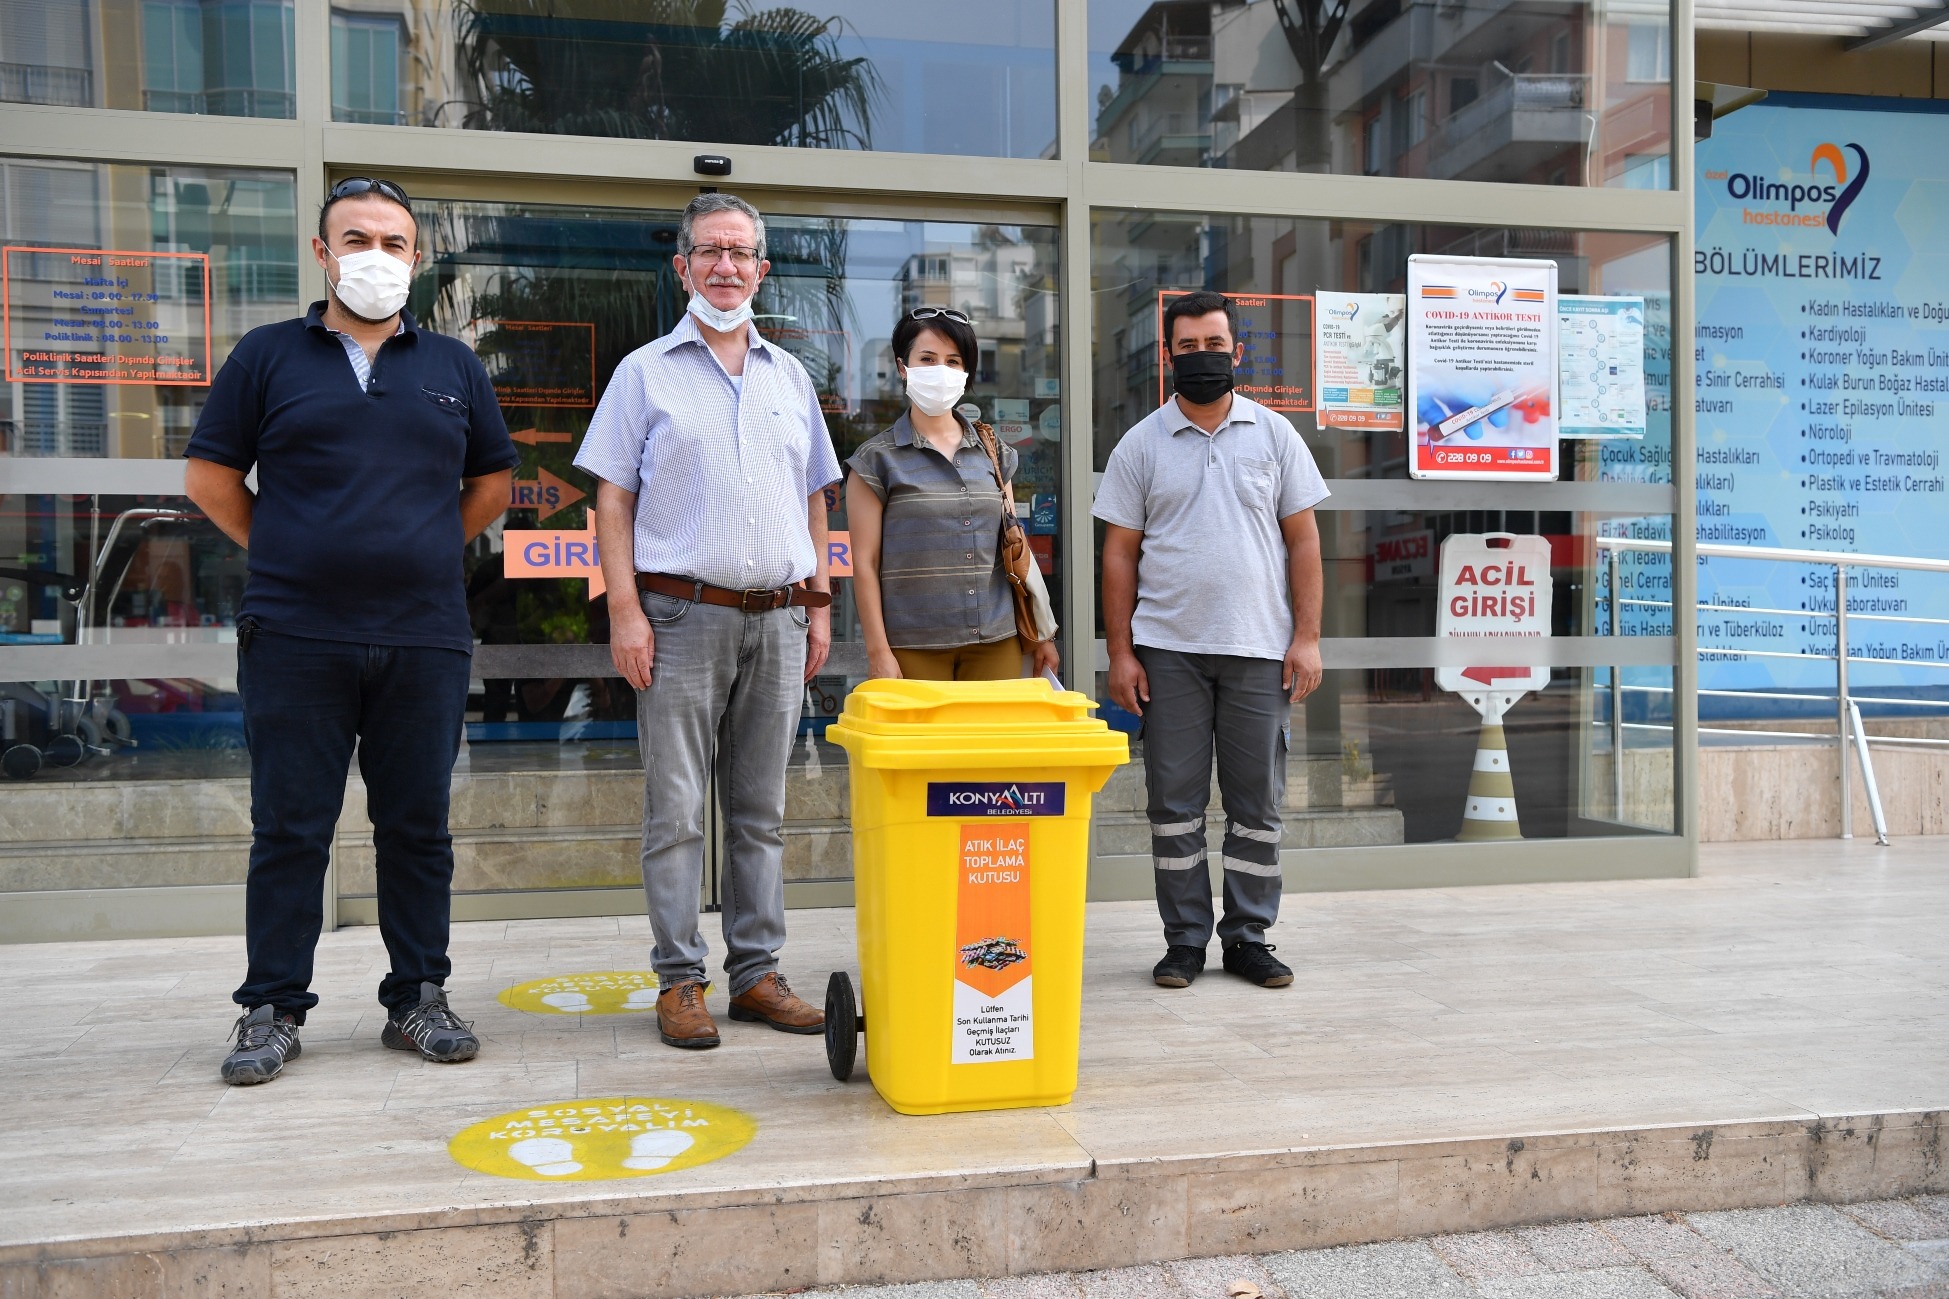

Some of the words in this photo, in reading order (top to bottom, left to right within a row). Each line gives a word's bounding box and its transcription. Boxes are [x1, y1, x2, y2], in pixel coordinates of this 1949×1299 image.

[1705, 170, 1728, 180] özel
[1728, 172, 1837, 211] Olimpos
[1743, 208, 1827, 228] hastanesi
[71, 256, 101, 265] Mesai
[108, 257, 149, 267] Saatleri
[1694, 246, 1882, 280] BÖLÜMLERİMİZ
[84, 277, 114, 287] Hafta
[116, 276, 128, 289] İçi
[53, 290, 84, 300] Mesai
[1468, 288, 1499, 299] Olimpos
[80, 305, 134, 316] Cumartesi
[1235, 299, 1266, 307] Saatleri
[1328, 308, 1352, 317] Olimpos
[1425, 310, 1469, 320] COVID-19
[1471, 310, 1513, 322] ANTİKOR
[1516, 312, 1541, 322] TESTİ
[1809, 299, 1839, 316] Kadın
[1842, 301, 1904, 319] Hastalıkları
[1907, 305, 1920, 318] ve
[1923, 302, 1949, 324] Doğu
[54, 319, 84, 328] Mesai
[132, 321, 159, 330] 13.00
[44, 332, 93, 342] Poliklinik
[102, 334, 132, 343] 08.00
[140, 335, 168, 345] 13.00
[1323, 331, 1333, 339] PCR
[1333, 331, 1346, 339] TESTİ
[1809, 324, 1866, 347] Kardiyoloji
[23, 352, 72, 363] Poliklinik
[74, 353, 115, 363] Saatleri
[117, 355, 155, 366] Dışında
[157, 356, 195, 367] Girişler
[1809, 347, 1853, 365] Koroner
[1856, 348, 1888, 370] Yoğun
[1891, 349, 1925, 367] Bakım
[1928, 347, 1949, 367] Ünit
[15, 367, 36, 376] Acil
[38, 367, 70, 377] Servis
[71, 367, 128, 379] Kapısından
[129, 369, 202, 381] Yapılmaktadır
[1705, 370, 1732, 388] Sinir
[1734, 371, 1785, 389] Cerrahisi
[1243, 384, 1273, 396] Dışında
[1274, 385, 1304, 396] Girişler
[1809, 372, 1840, 390] Kulak
[1843, 373, 1876, 391] Burun
[1879, 373, 1912, 395] Boğaz
[1915, 375, 1949, 392] Hastal
[1254, 397, 1309, 408] Yapılmaktadır
[1809, 398, 1840, 415] Lazer
[1843, 398, 1895, 420] Epilasyon
[1898, 396, 1935, 417] Ünitesi
[1809, 423, 1852, 445] Nöroloji
[1447, 453, 1464, 463] 228
[1466, 454, 1477, 463] 09
[1480, 454, 1492, 463] 09
[1601, 445, 1636, 466] Çocuk
[1696, 446, 1760, 465] Hastalıkları
[1809, 448, 1855, 470] Ortopedi
[1858, 452, 1870, 465] ve
[1873, 449, 1939, 471] Travmatoloji
[1809, 474, 1846, 491] Plastik
[1849, 478, 1861, 491] ve
[1865, 475, 1901, 492] Estetik
[1904, 475, 1944, 492] Cerrahi
[511, 481, 561, 509] İRİŞ
[1809, 500, 1859, 521] Psikiyatri
[1601, 522, 1629, 538] Fizik
[1631, 522, 1667, 540] Tedavi
[1696, 523, 1767, 545] ehabilitasyon
[1809, 524, 1855, 545] Psikolog
[523, 535, 600, 567] GİRİ
[1454, 561, 1535, 586] ACİL
[1637, 571, 1672, 589] Cerrah
[1809, 572, 1829, 593] Saç
[1862, 569, 1899, 588] Ünitesi
[1450, 590, 1536, 623] GİRİŞİ
[1846, 597, 1908, 612] aboratuvarı
[1708, 625, 1721, 638] ve
[1723, 620, 1784, 638] Tüberküloz
[1865, 641, 1898, 660] Yoğun
[1901, 643, 1935, 660] Bakım
[964, 839, 994, 852] ATIK
[996, 838, 1025, 854] İLAÇ
[963, 854, 1025, 869] TOPLAMA
[968, 870, 1020, 884] KUTUSU
[528, 984, 652, 993] KORUYAL
[539, 977, 644, 988] MESAFE
[980, 1005, 1004, 1014] Lütfen
[957, 1017, 972, 1026] Son
[973, 1015, 1008, 1025] Kullanma
[1009, 1014, 1029, 1022] Tarihi
[966, 1027, 994, 1037] Geçmiş
[995, 1025, 1020, 1036] İlaçları
[975, 1036, 1011, 1047] KUTUSUZ
[969, 1047, 993, 1057] Olarak
[994, 1046, 1017, 1055] Atınız.
[527, 1103, 670, 1118] SOSYAL
[505, 1108, 693, 1129] MESAFEYİ
[489, 1117, 710, 1140] KORUYALIM
